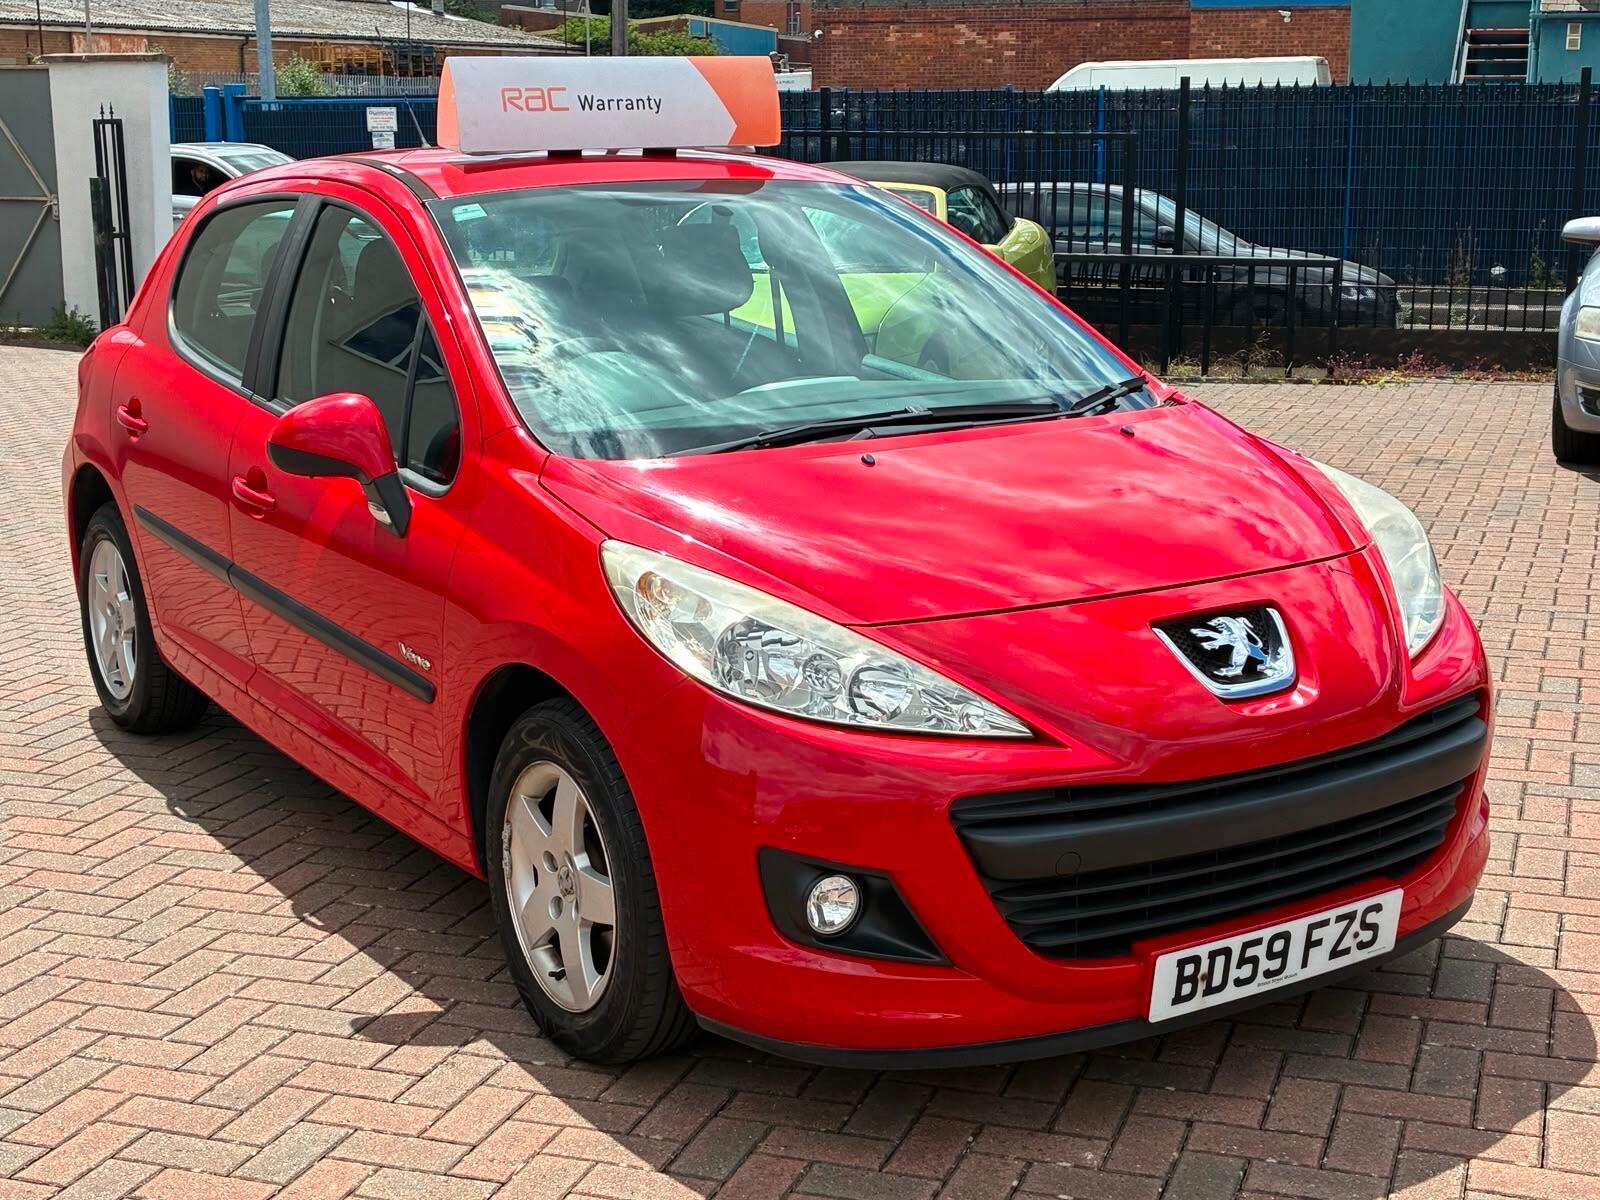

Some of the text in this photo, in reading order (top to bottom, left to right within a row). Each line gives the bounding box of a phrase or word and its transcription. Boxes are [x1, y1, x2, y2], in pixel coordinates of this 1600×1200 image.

[577, 94, 662, 114] Warranty
[1171, 903, 1383, 1006] BD59 FZS
